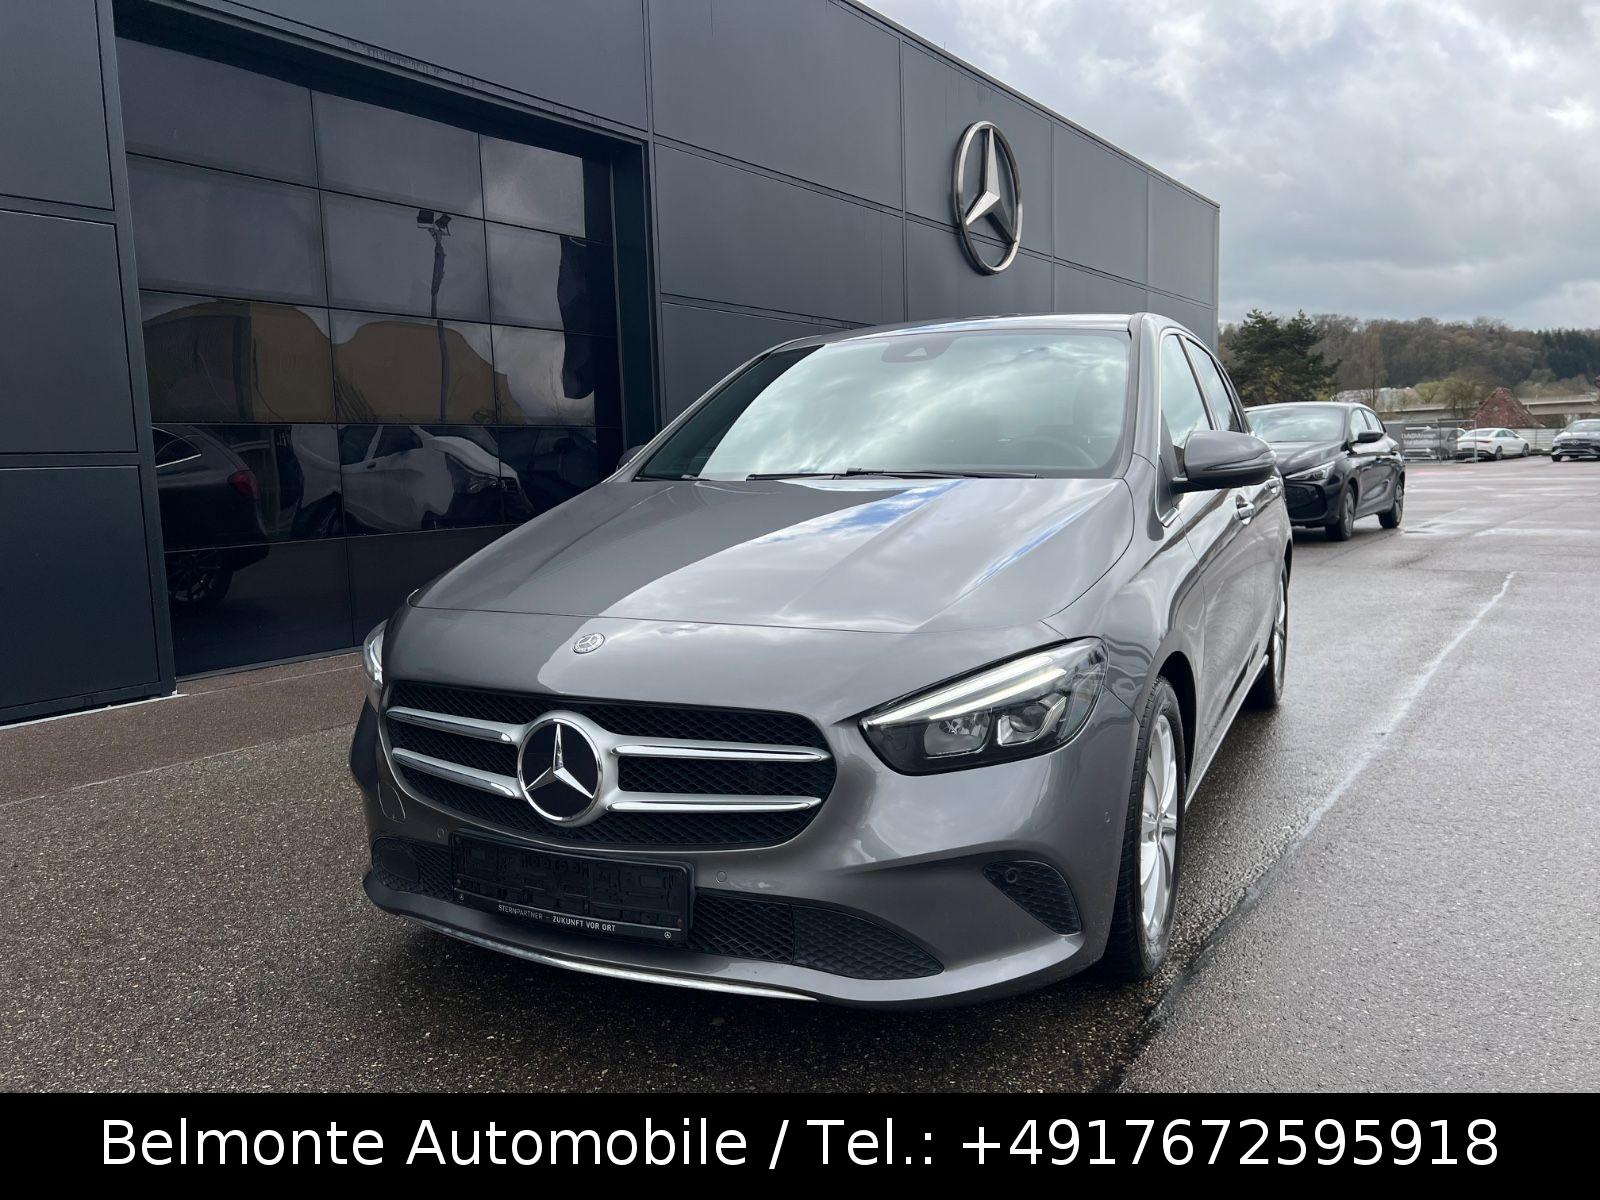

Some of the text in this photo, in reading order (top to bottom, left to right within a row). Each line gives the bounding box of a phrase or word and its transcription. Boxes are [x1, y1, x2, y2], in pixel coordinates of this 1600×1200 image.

[498, 904, 543, 920] STERNPARTNER
[552, 915, 584, 927] ZUKUNFT
[585, 922, 600, 930] VOR
[602, 923, 616, 932] ORT
